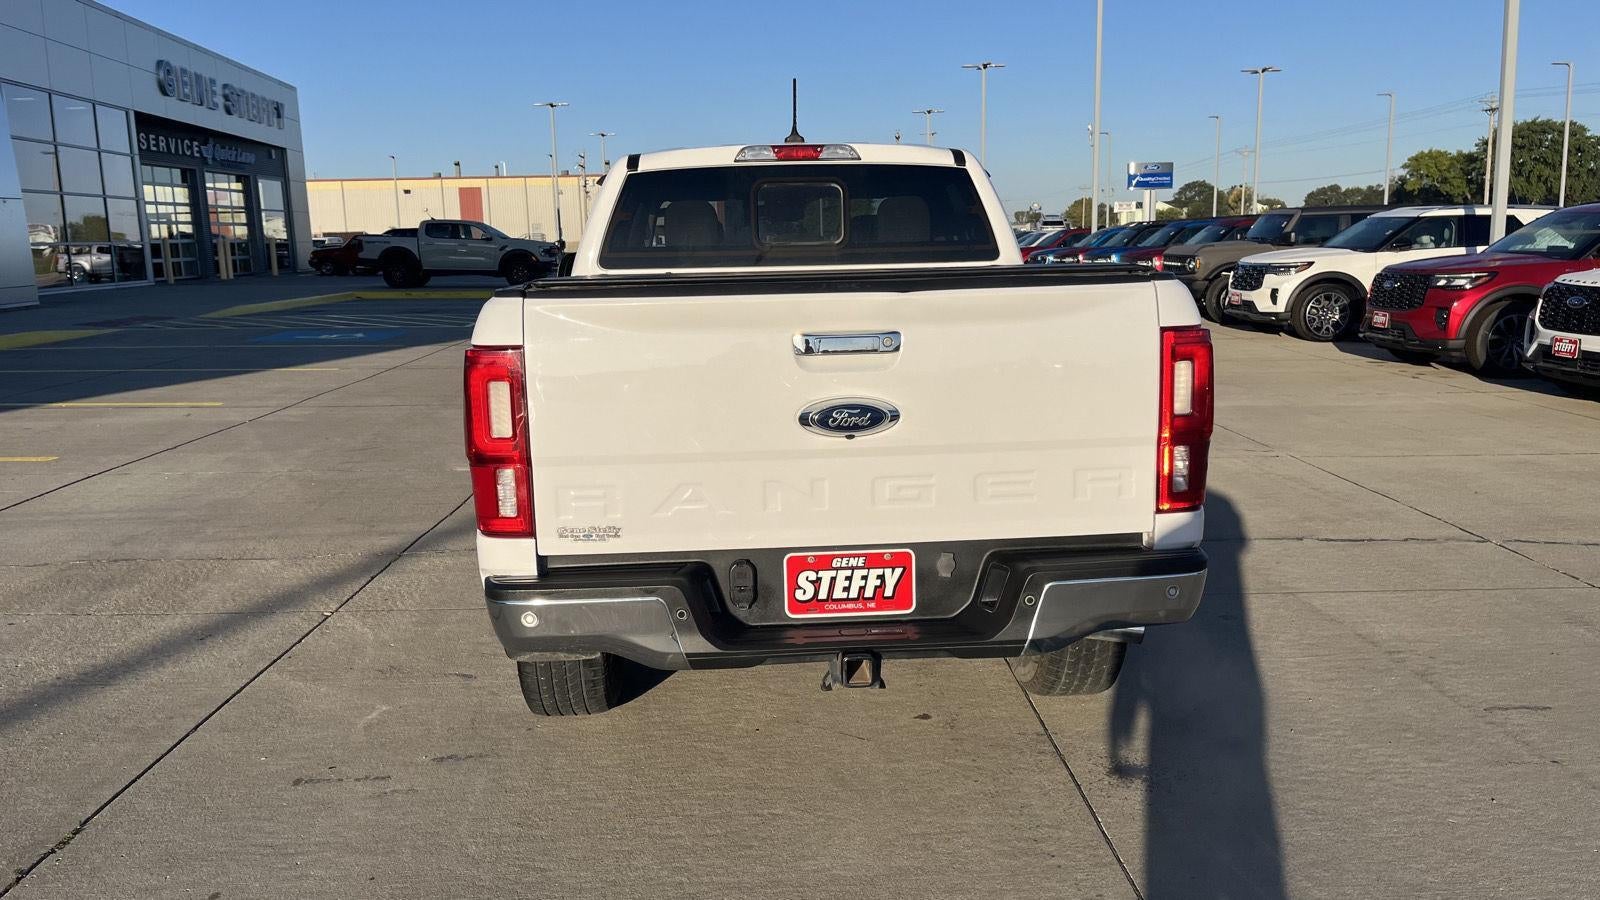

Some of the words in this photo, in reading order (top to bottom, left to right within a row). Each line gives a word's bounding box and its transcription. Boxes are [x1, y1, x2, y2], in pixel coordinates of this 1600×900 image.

[156, 60, 219, 110] GENE
[222, 84, 286, 130] STEFFY
[139, 132, 201, 158] SERVICE
[1555, 341, 1576, 353] STEFFY
[828, 408, 872, 428] Ford
[555, 466, 1137, 518] RANGER
[831, 556, 867, 568] GENE
[794, 566, 906, 602] STEFFY
